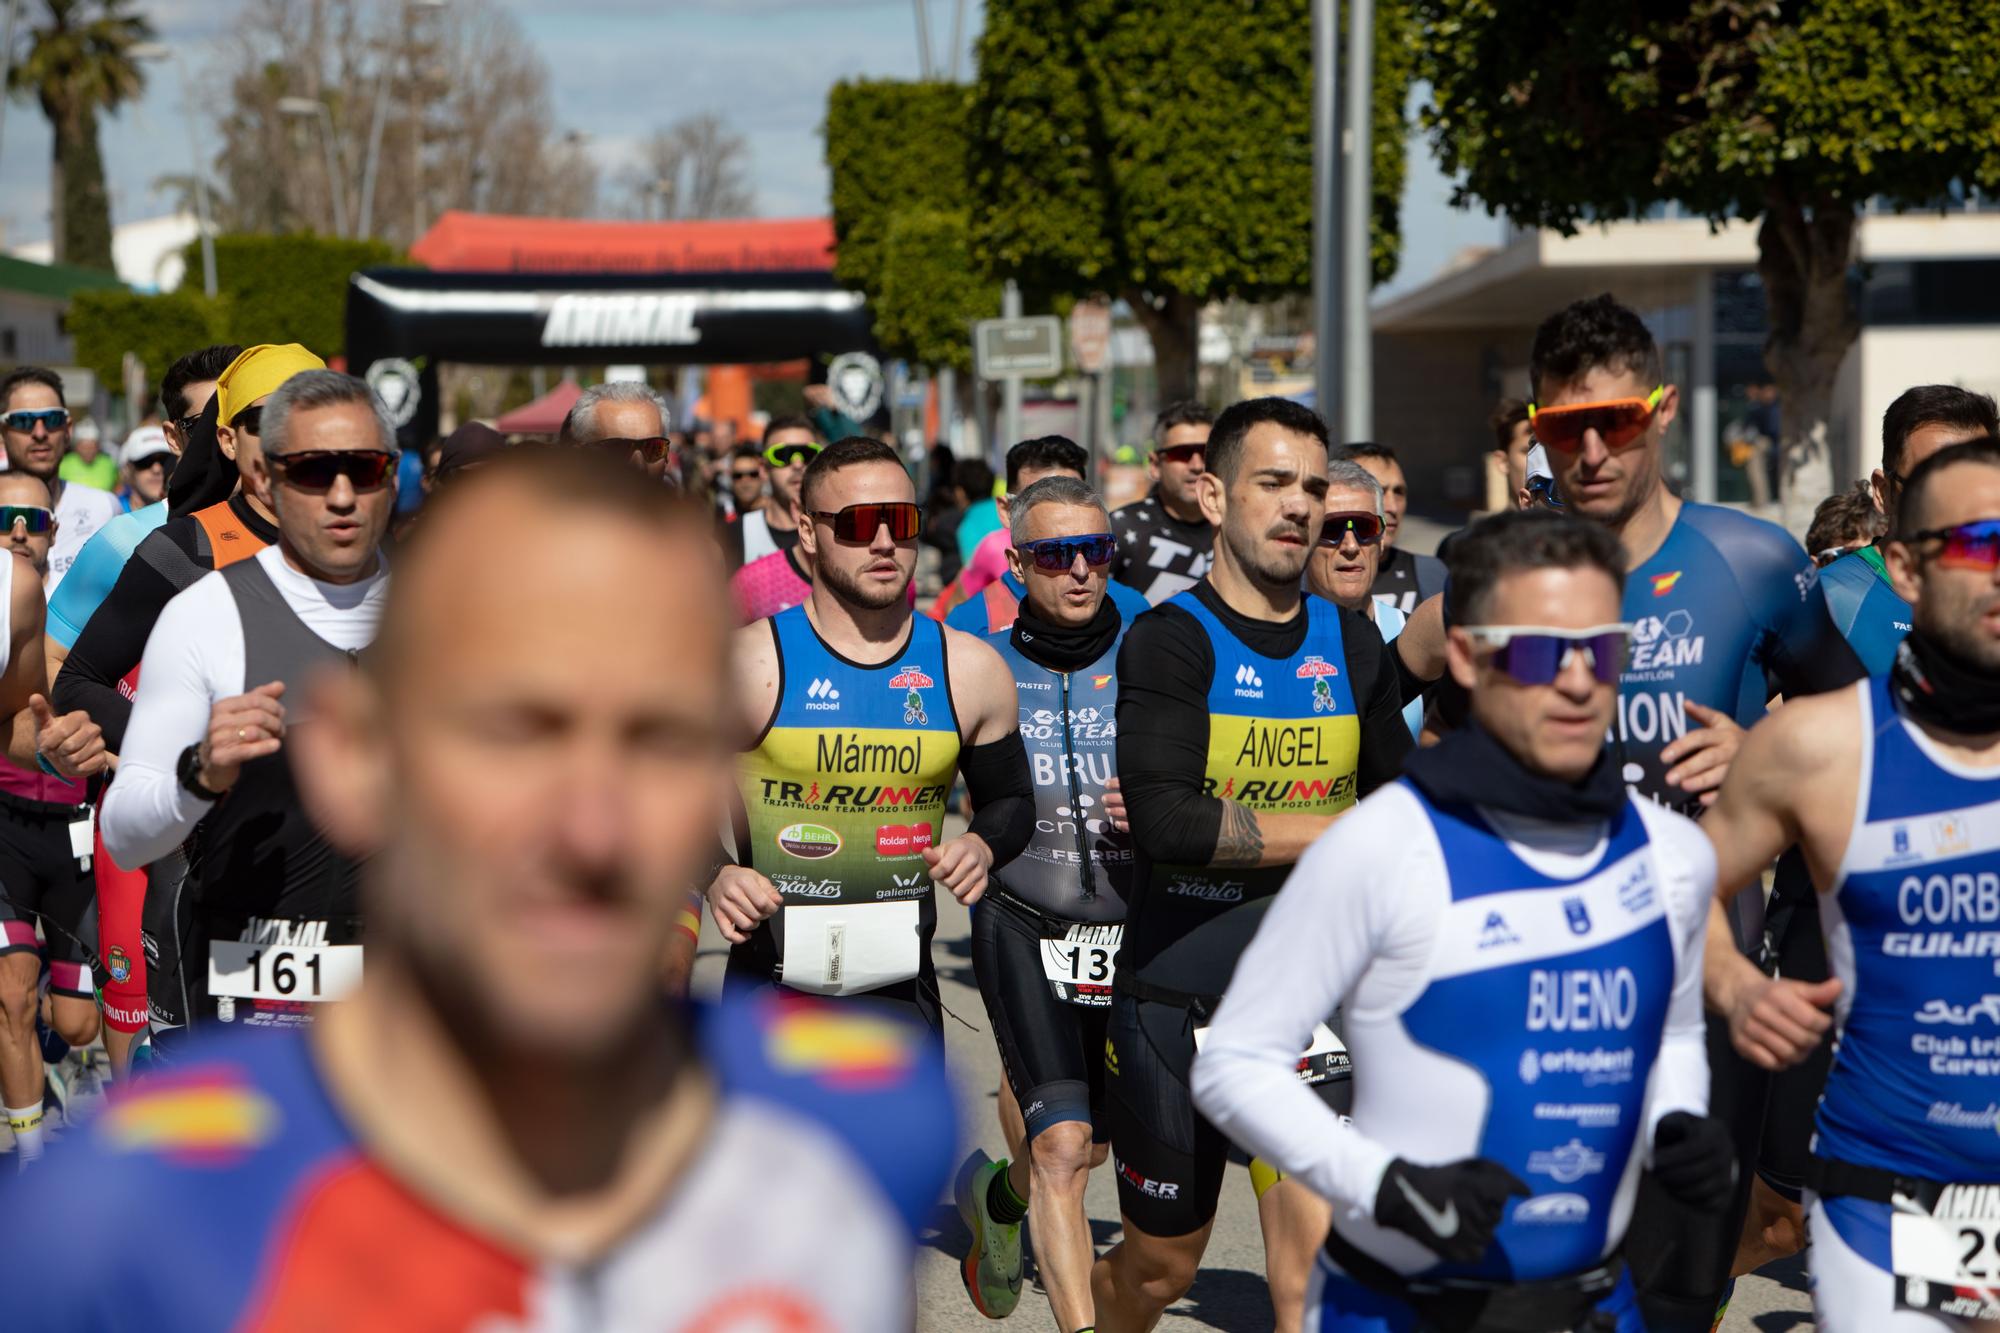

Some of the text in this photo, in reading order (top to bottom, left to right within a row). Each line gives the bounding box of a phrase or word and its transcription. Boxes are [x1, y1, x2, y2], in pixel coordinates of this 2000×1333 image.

[1016, 681, 1052, 691] FASTER
[1235, 688, 1264, 699] mobel
[805, 701, 840, 711] mobel
[1235, 720, 1329, 767] ÁNGEL
[817, 734, 921, 774] Mármol
[1033, 752, 1111, 786] BRU
[763, 798, 829, 812] TRIATHLON
[836, 805, 865, 813] TEAM
[1281, 801, 1311, 809] POZO
[804, 832, 832, 841] BEHR
[880, 836, 909, 845] Roldan
[771, 873, 807, 881] CICLOS
[876, 885, 930, 899] galiempleo
[248, 950, 321, 996] 161
[1525, 966, 1638, 1032] BUENO
[104, 1001, 148, 1024] TRIATLÓN
[1911, 1033, 1967, 1056] Club
